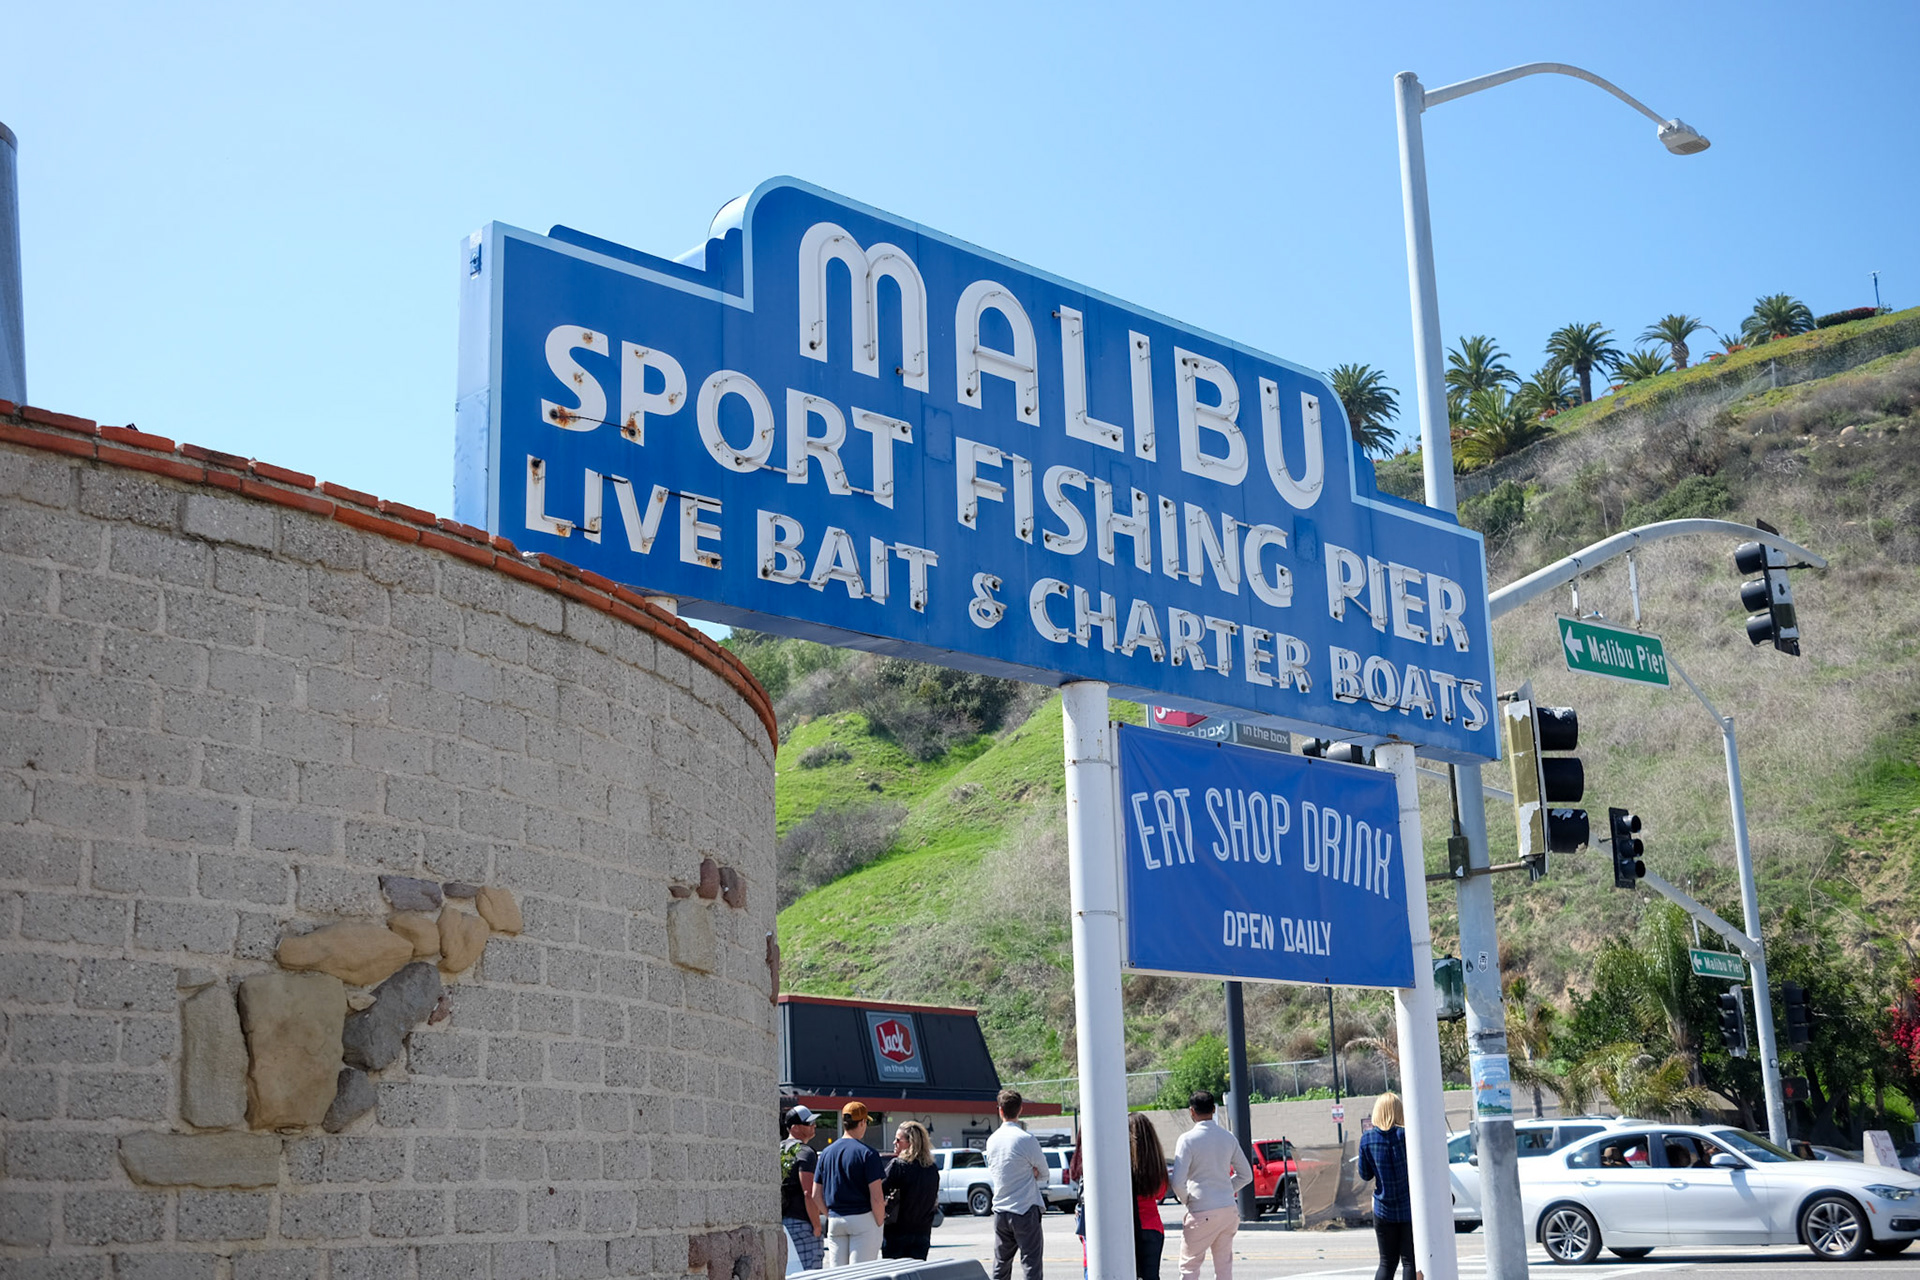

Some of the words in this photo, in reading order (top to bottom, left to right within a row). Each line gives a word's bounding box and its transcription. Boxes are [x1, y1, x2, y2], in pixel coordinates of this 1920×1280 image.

[799, 222, 1325, 509] MALIBU
[541, 325, 913, 509] SPORT
[956, 437, 1293, 607] FISHING
[1324, 543, 1470, 653] PIER
[525, 455, 723, 570] LIVE
[757, 510, 939, 613] BAIT
[968, 572, 1007, 629] &
[1029, 578, 1313, 693] CHARTER
[1329, 645, 1489, 732] BOATS
[1586, 635, 1635, 669] Malibu
[1636, 645, 1665, 675] Pier
[1198, 724, 1225, 738] box
[1243, 725, 1253, 736] in
[1253, 726, 1269, 741] the
[1270, 730, 1289, 744] box
[1131, 788, 1195, 870] EAT
[1205, 787, 1290, 866] SHOP
[1302, 801, 1393, 899] DRINK
[1223, 910, 1274, 950] OPEN
[1280, 917, 1332, 956] DAILY
[1703, 956, 1728, 972] Malibu
[1728, 959, 1742, 973] Pier
[879, 1023, 913, 1055] Jack
[904, 1065, 919, 1073] box
